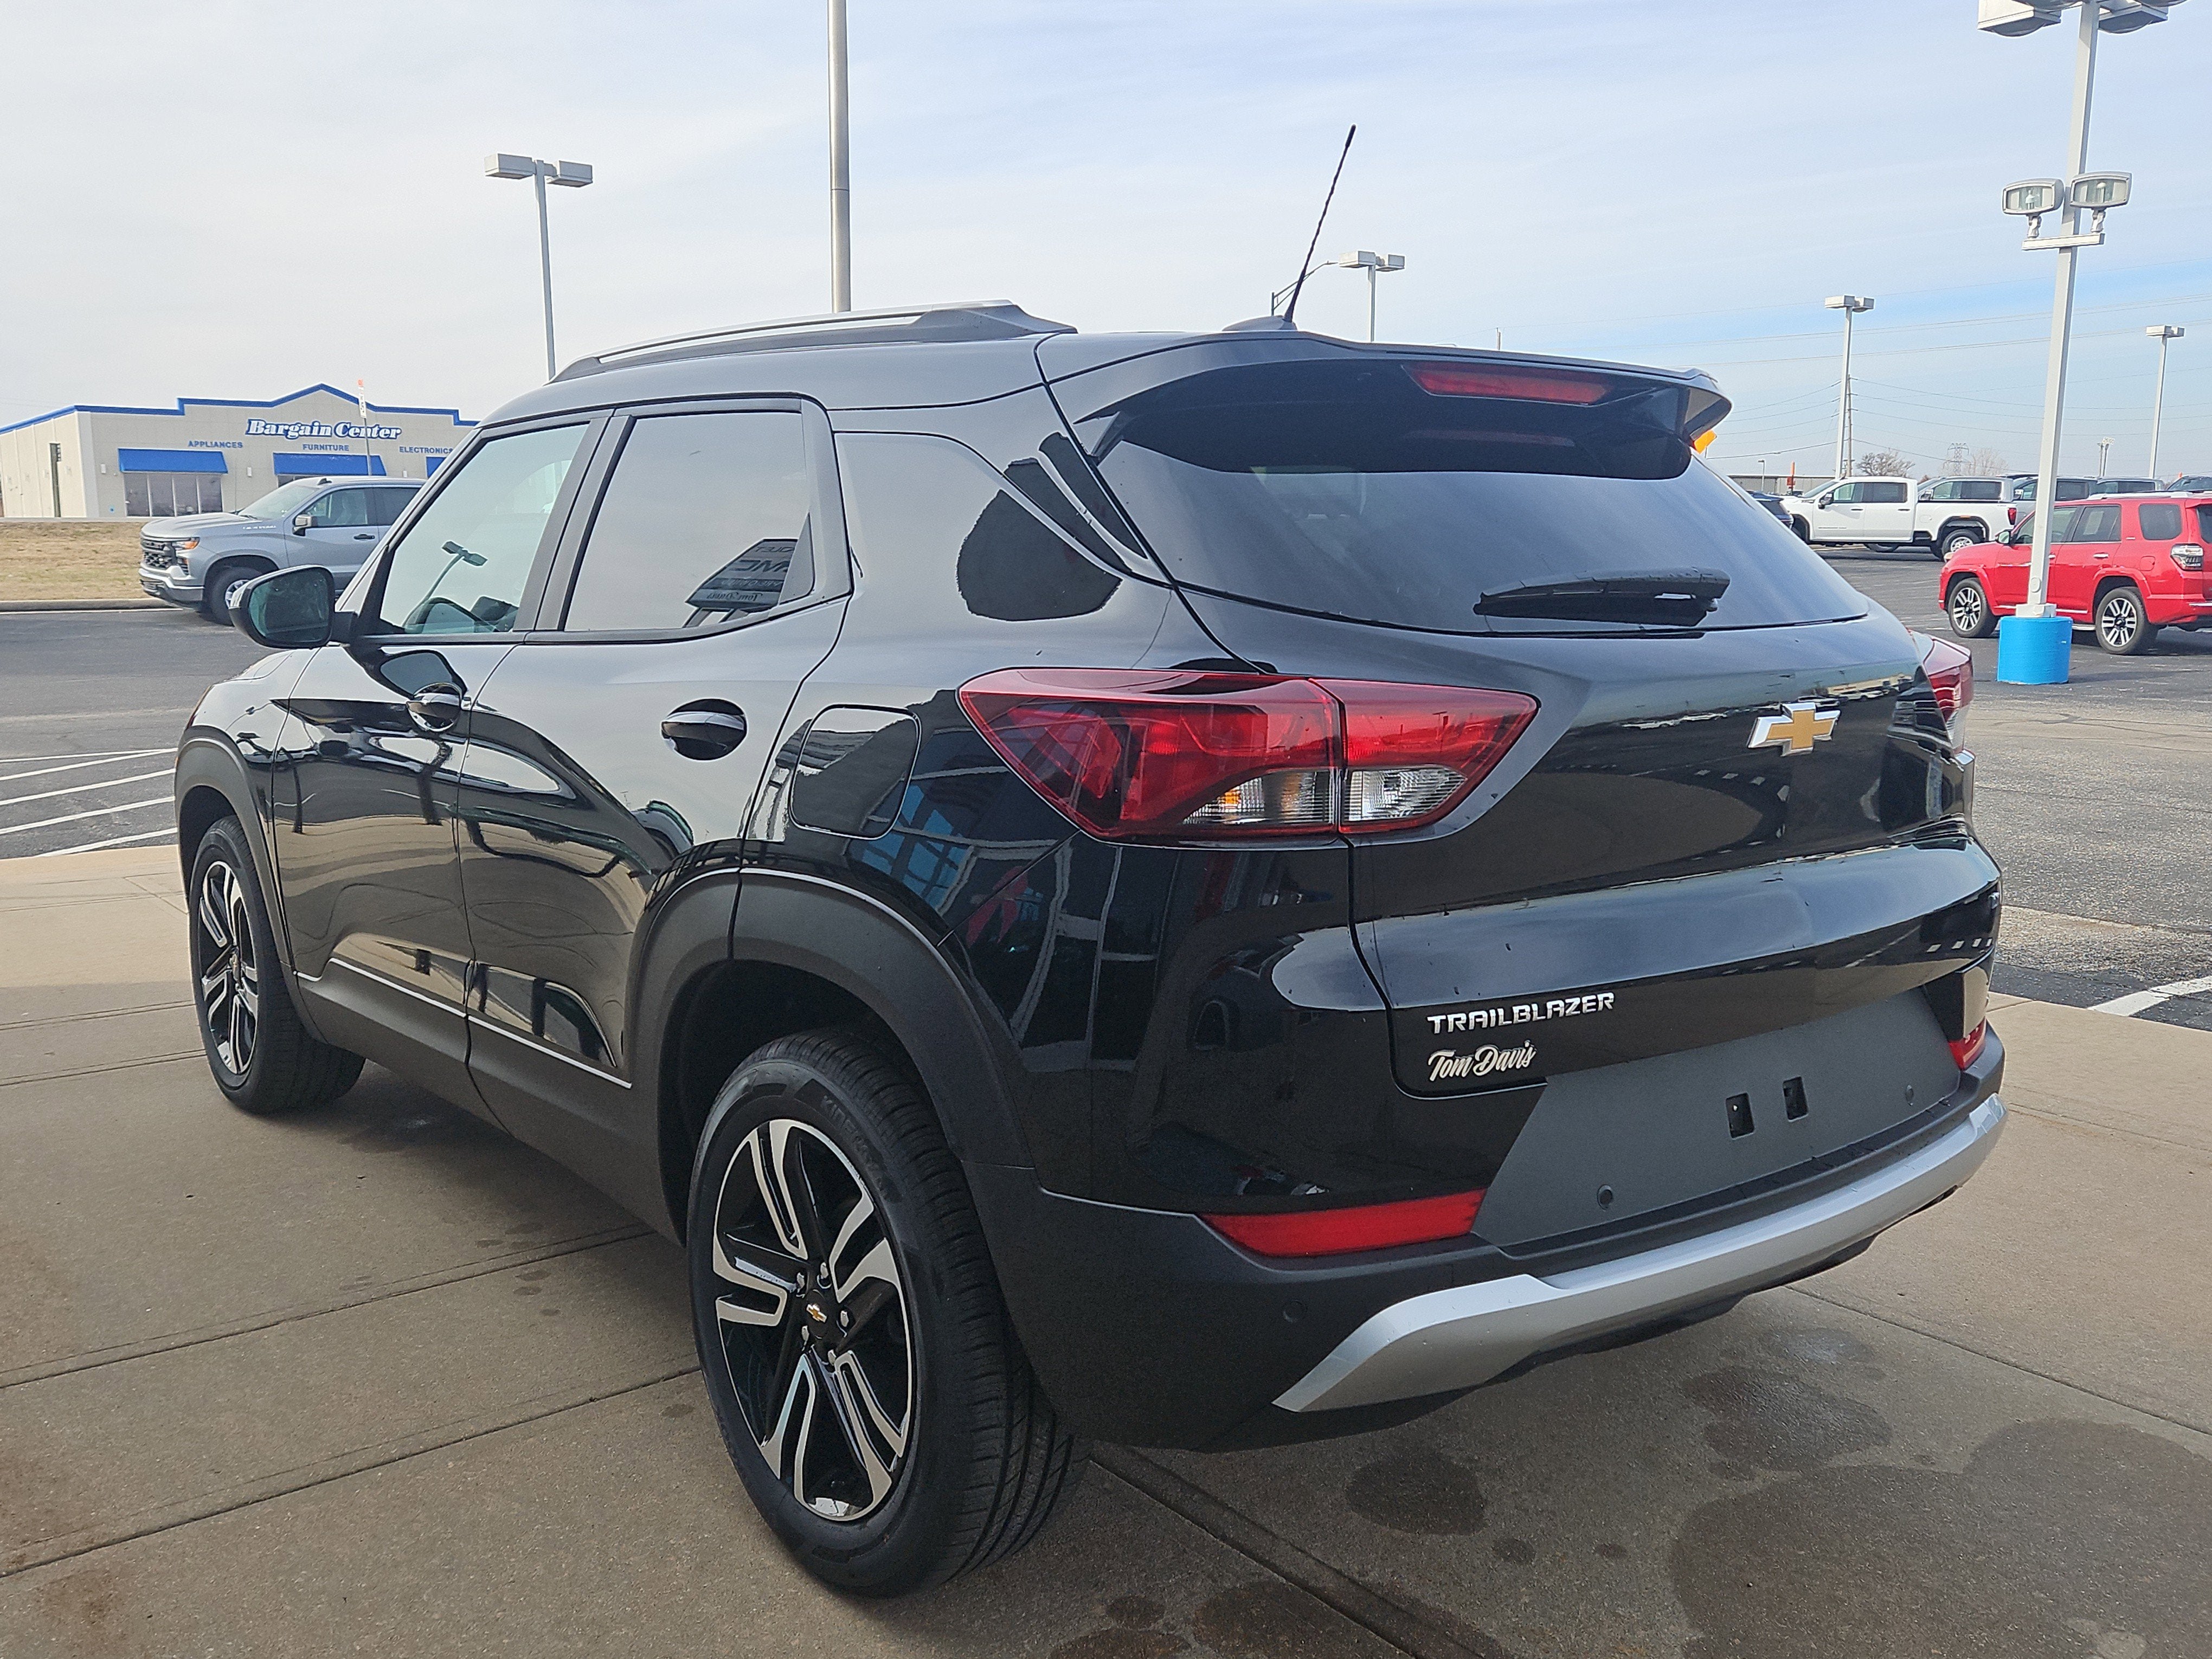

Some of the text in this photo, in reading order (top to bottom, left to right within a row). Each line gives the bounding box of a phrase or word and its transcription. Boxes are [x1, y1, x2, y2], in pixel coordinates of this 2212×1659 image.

[245, 419, 401, 440] Bargain Center
[188, 440, 243, 449] APPLIANCES
[303, 443, 349, 452] FURNITURE
[1427, 992, 1615, 1034] TRAILBLAZER
[1427, 1039, 1537, 1082] Tom Davis
